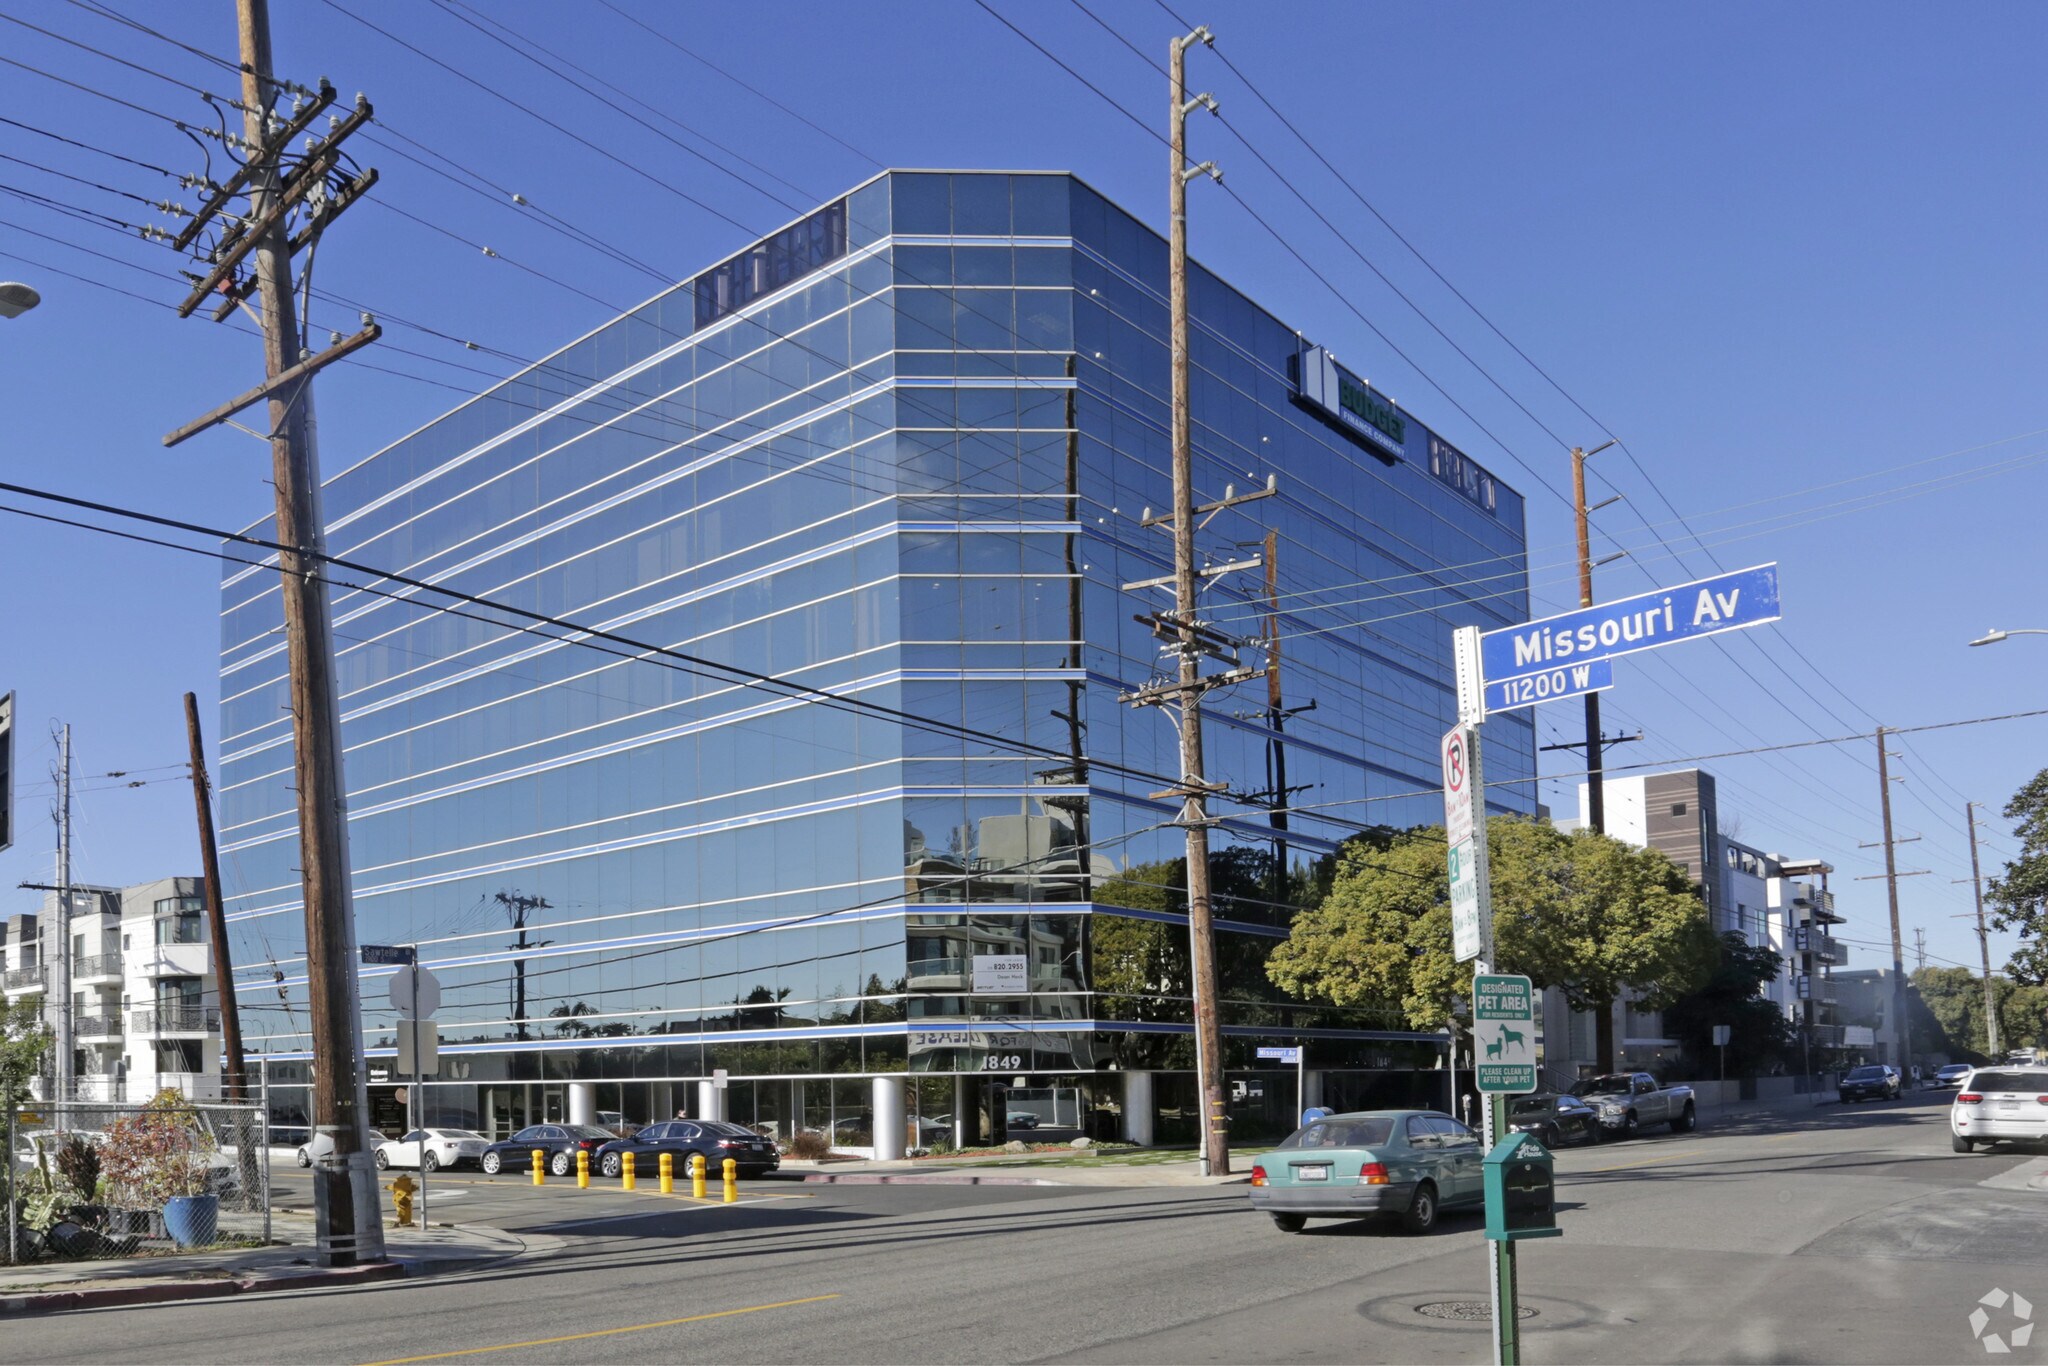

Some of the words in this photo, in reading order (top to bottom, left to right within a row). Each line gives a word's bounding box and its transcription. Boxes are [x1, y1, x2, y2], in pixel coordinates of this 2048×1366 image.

[1341, 379, 1406, 445] BUDGET
[1343, 411, 1373, 437] FINANCE
[1374, 431, 1405, 457] COMPANY
[1513, 597, 1674, 667] Missouri
[1693, 588, 1740, 626] Av
[1503, 670, 1566, 705] 11200
[1572, 665, 1591, 689] W
[1450, 853, 1457, 878] 2
[1452, 878, 1475, 907] PARKING
[364, 947, 398, 957] Sawtelle
[1481, 984, 1524, 994] DESIGNATED
[1478, 995, 1498, 1010] PET
[1501, 996, 1528, 1011] AREA
[983, 1055, 1021, 1070] 1849
[1481, 1067, 1502, 1075] PLEASE
[1503, 1067, 1522, 1075] CLEAN
[1522, 1067, 1531, 1075] UP
[1483, 1075, 1501, 1083] AFTER
[1502, 1075, 1518, 1083] YOUR
[1519, 1075, 1530, 1083] PET
